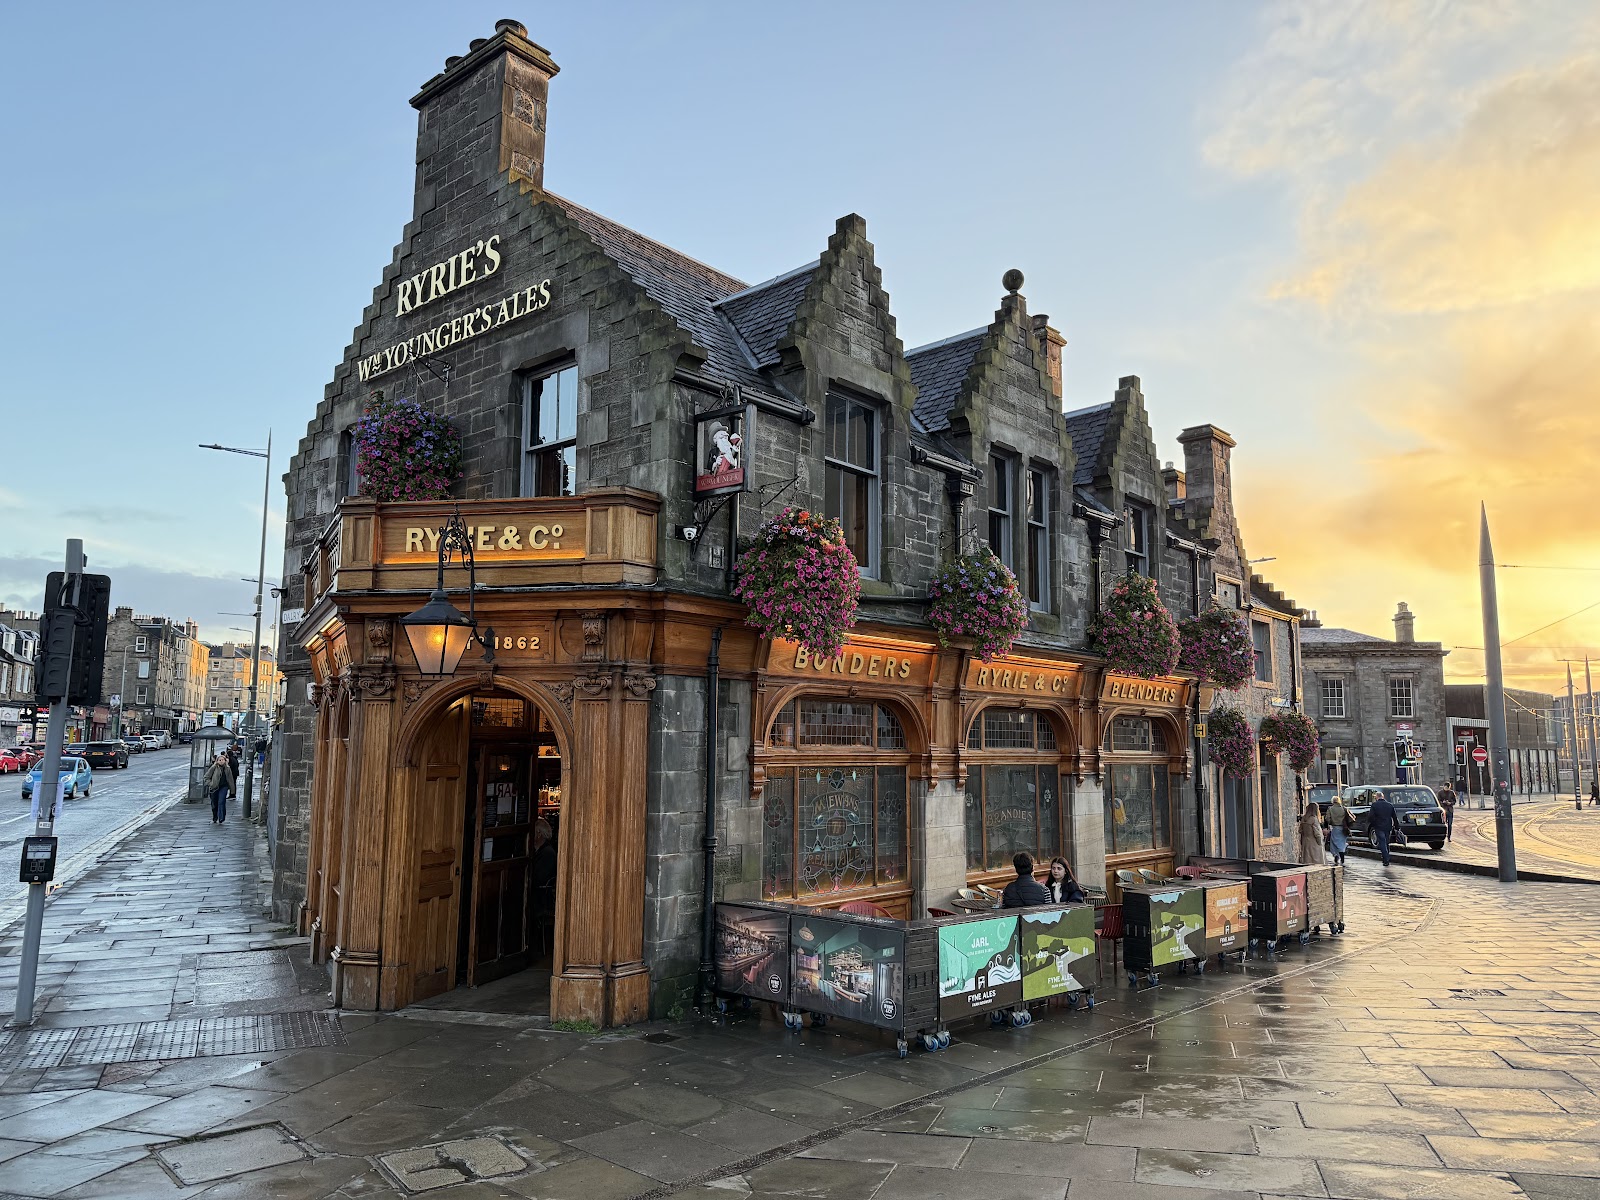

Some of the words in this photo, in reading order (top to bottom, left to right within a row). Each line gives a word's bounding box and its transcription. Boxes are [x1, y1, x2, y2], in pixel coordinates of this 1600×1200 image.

[396, 234, 501, 318] RYRIE'S
[385, 305, 493, 371] YOUNGER'S
[496, 278, 551, 327] ALES
[498, 525, 523, 551] &
[494, 636, 541, 650] 1862
[794, 646, 911, 679] BONDERS
[977, 666, 1030, 690] RYRIE
[1034, 672, 1045, 691] &
[1110, 681, 1176, 703] BLENDERS
[986, 808, 1033, 825] BRANDIES
[807, 853, 834, 868] REAL
[838, 847, 861, 867] ALE
[971, 936, 990, 949] JARL
[1047, 976, 1061, 984] FYNE
[1061, 973, 1074, 982] ALES
[967, 992, 982, 1003] FYNE
[982, 990, 997, 1000] ALES
